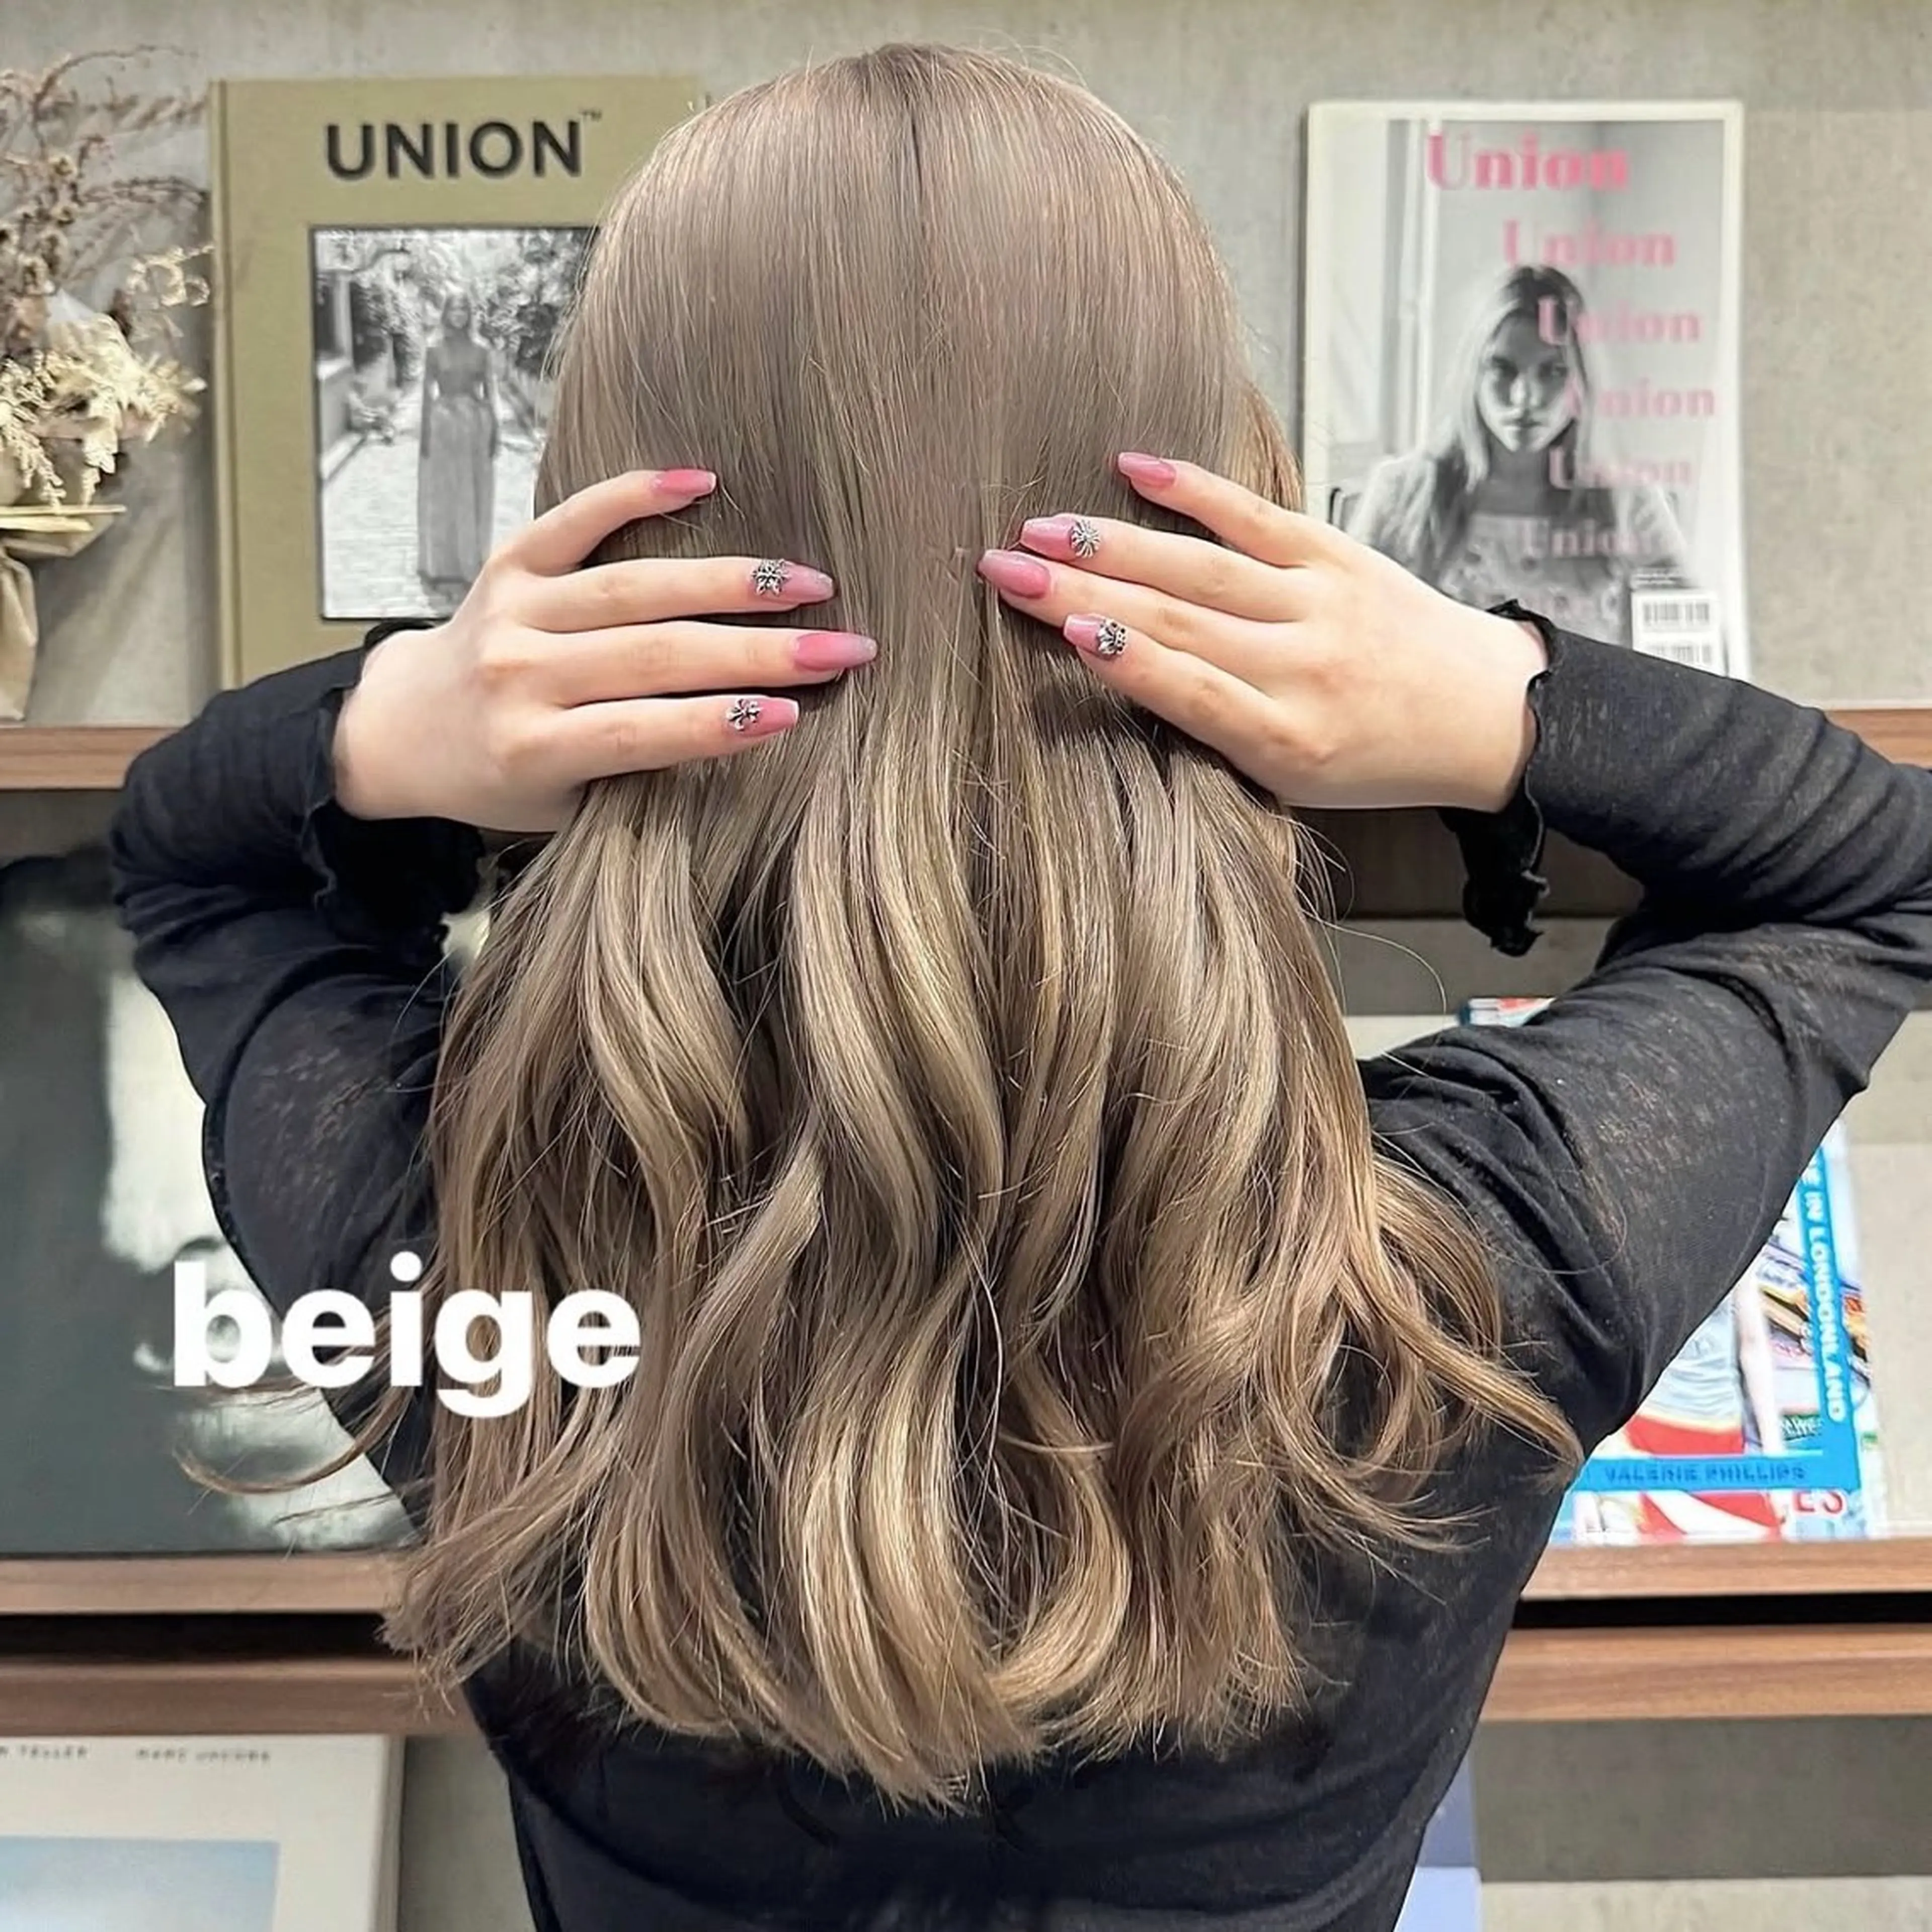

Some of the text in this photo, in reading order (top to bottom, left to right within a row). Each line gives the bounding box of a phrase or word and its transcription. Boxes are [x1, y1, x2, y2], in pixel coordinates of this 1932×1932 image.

[326, 119, 582, 179] UNION
[1426, 130, 1630, 190] Union
[1804, 1192, 1824, 1221] IN
[1808, 1224, 1847, 1423] LONDONLAND
[1605, 1463, 1806, 1483] VALERIE PHILLIPS
